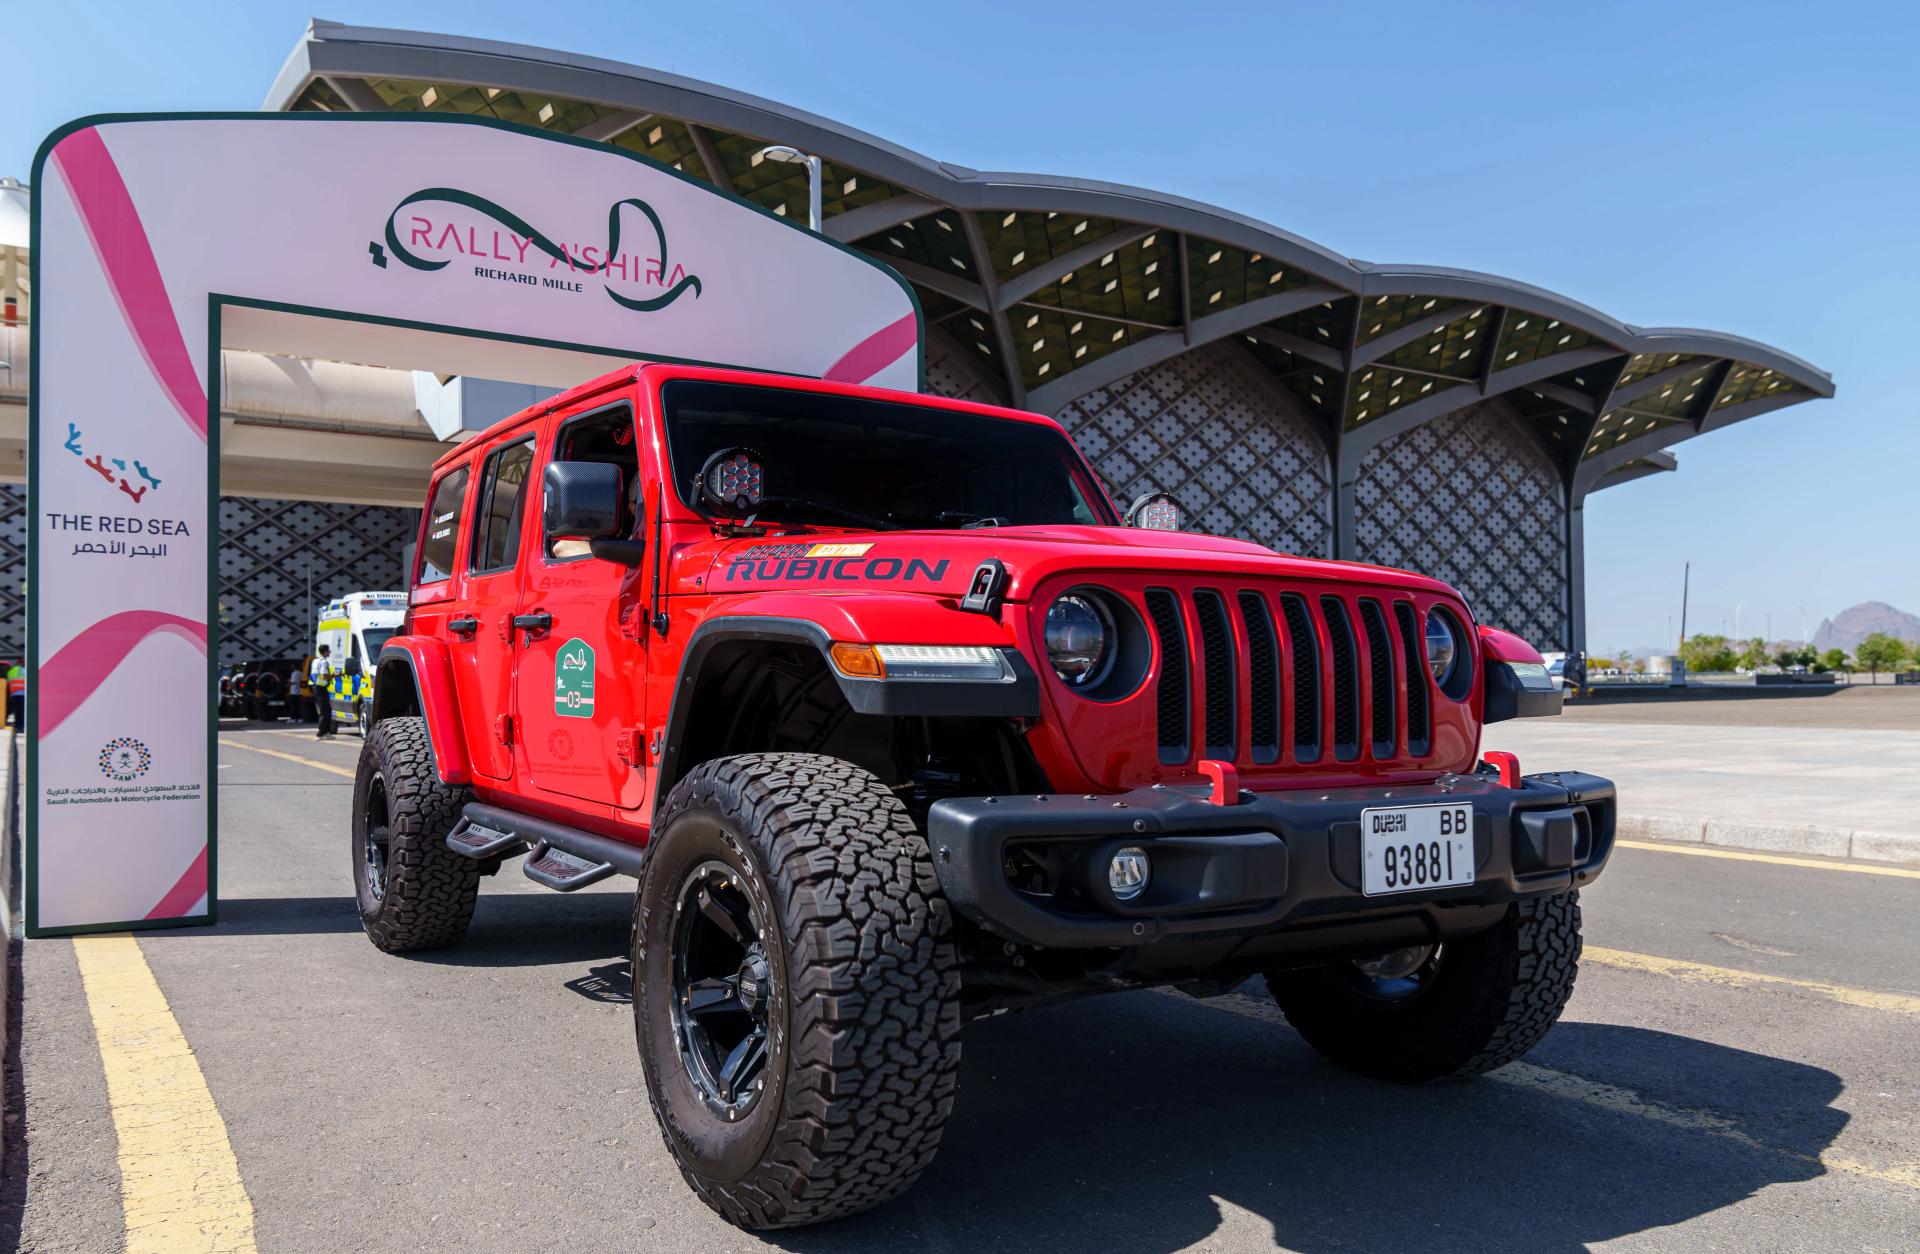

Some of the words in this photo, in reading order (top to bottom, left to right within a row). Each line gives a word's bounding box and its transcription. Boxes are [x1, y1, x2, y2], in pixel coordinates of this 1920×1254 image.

[411, 216, 534, 264] RALLY
[474, 266, 538, 286] RICHARD
[542, 277, 583, 293] MILLE
[46, 513, 93, 532] THE
[99, 516, 143, 533] RED
[147, 518, 190, 536] SEA
[72, 540, 126, 556] الأحمر
[129, 543, 167, 558] البحر
[725, 558, 950, 582] RUBICON
[567, 691, 581, 708] 03
[46, 798, 69, 806] Saudi
[69, 796, 113, 805] Automobile
[121, 795, 161, 803] Motorcycle
[162, 793, 200, 801] Federation
[1440, 809, 1467, 835] BB
[1384, 840, 1452, 888] 93881
